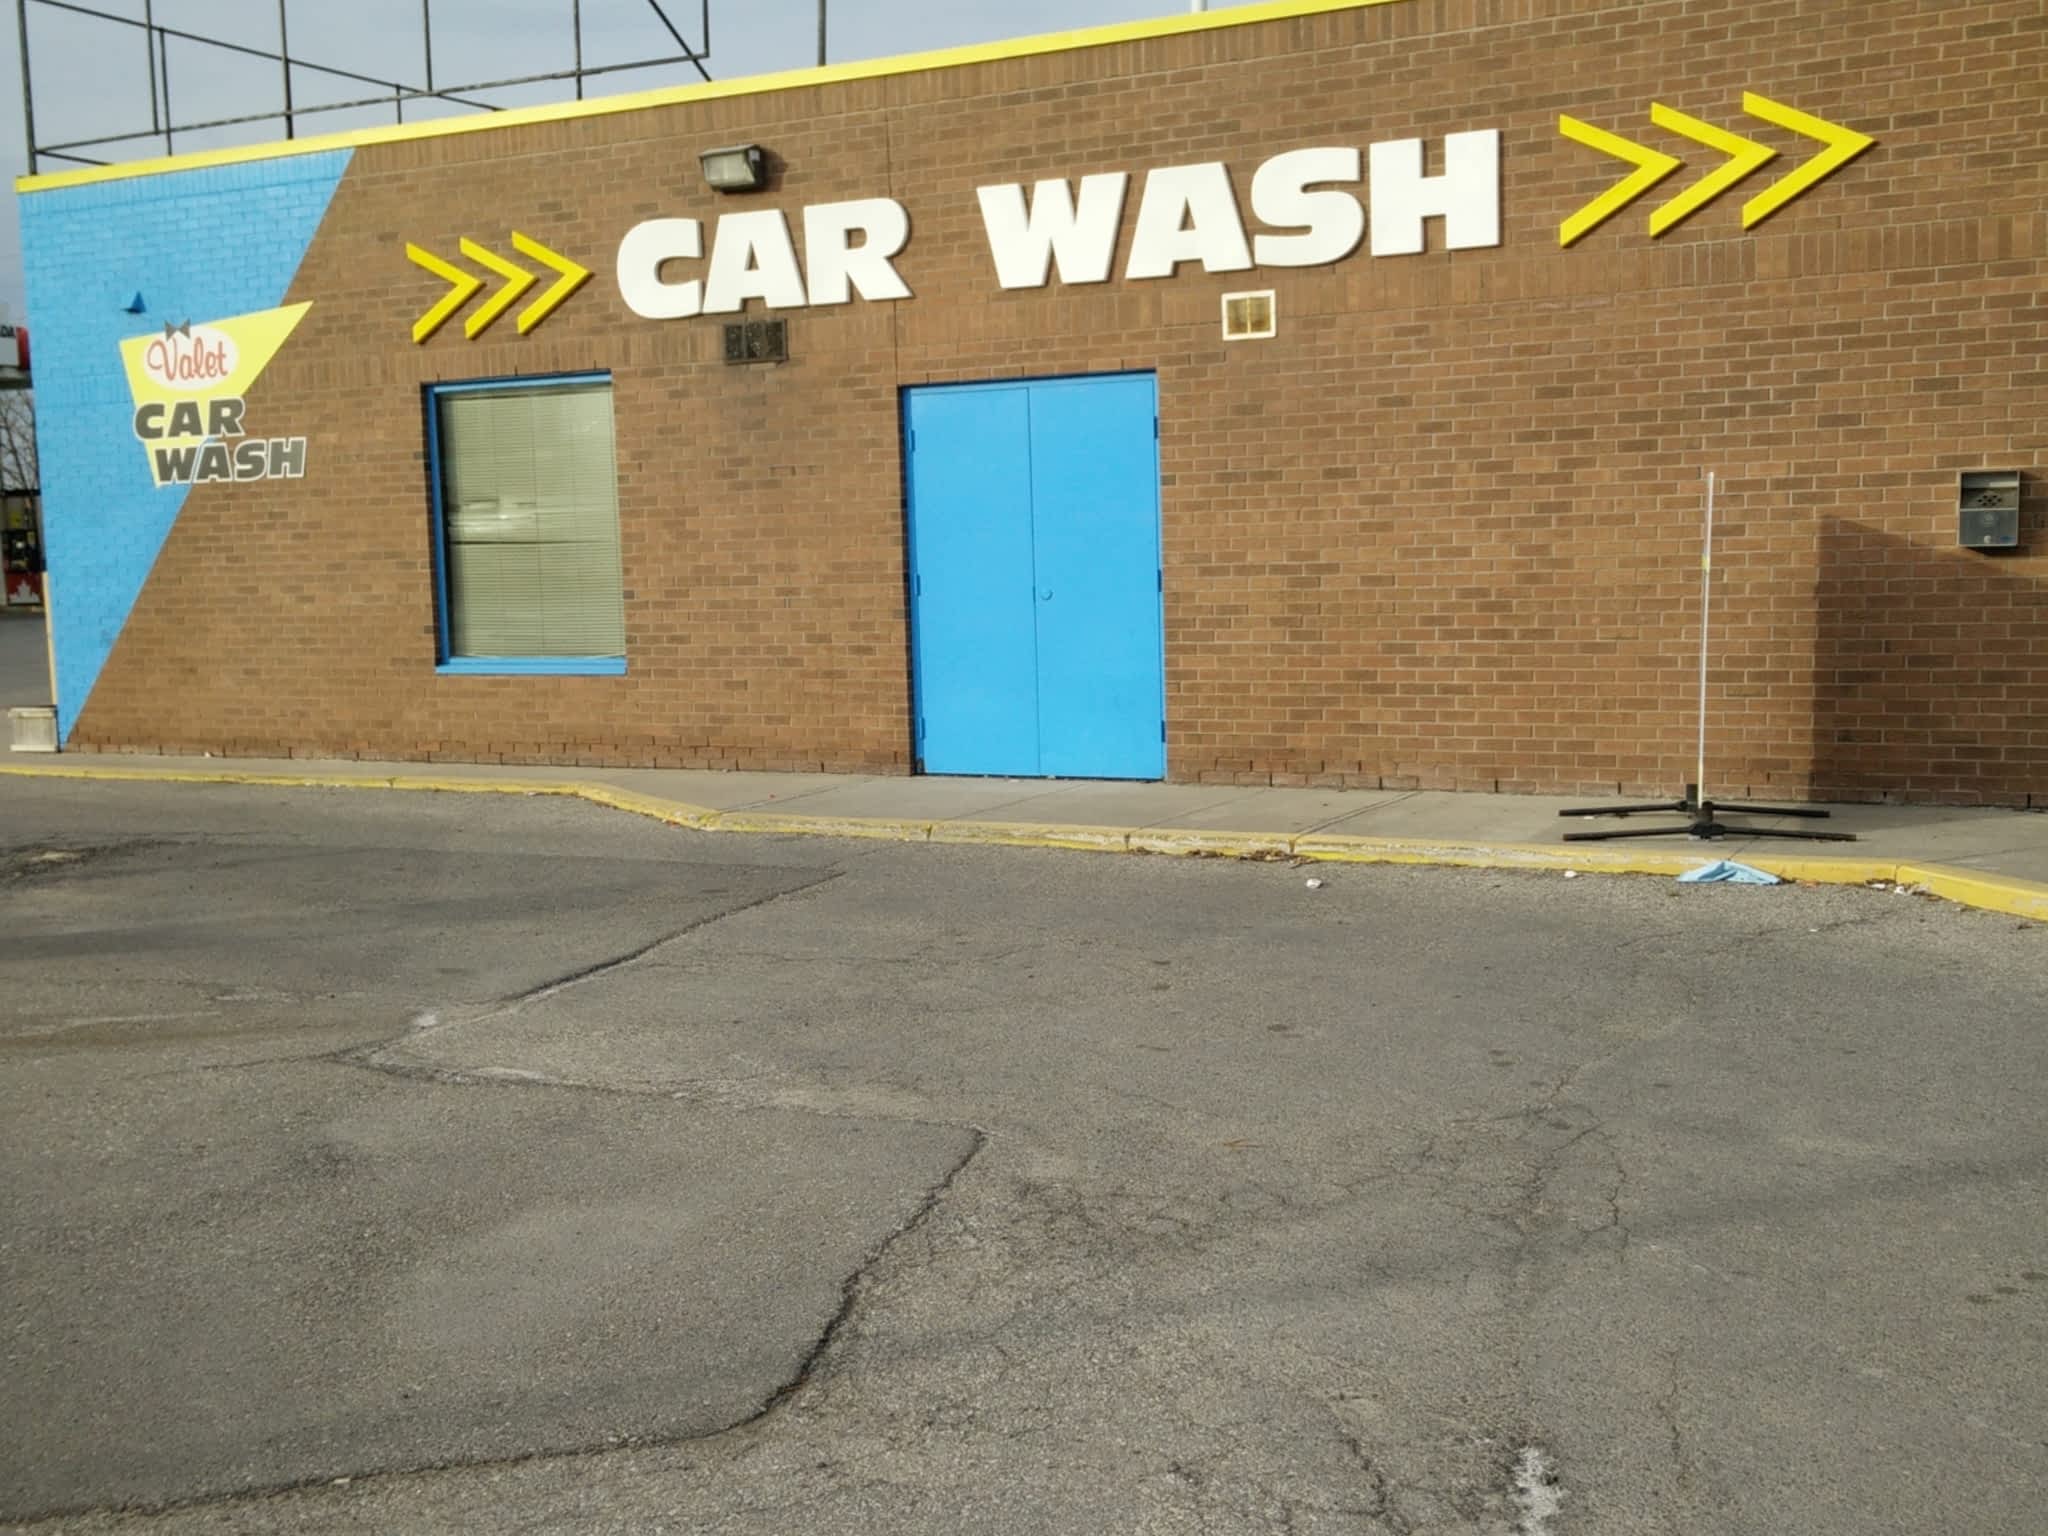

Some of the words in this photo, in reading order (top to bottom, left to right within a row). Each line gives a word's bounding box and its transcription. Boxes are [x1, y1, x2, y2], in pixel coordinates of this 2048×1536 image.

[616, 198, 911, 318] CAR
[977, 129, 1501, 290] WASH
[147, 336, 228, 381] Valet
[135, 398, 245, 440] CAR
[154, 437, 307, 485] WASH
